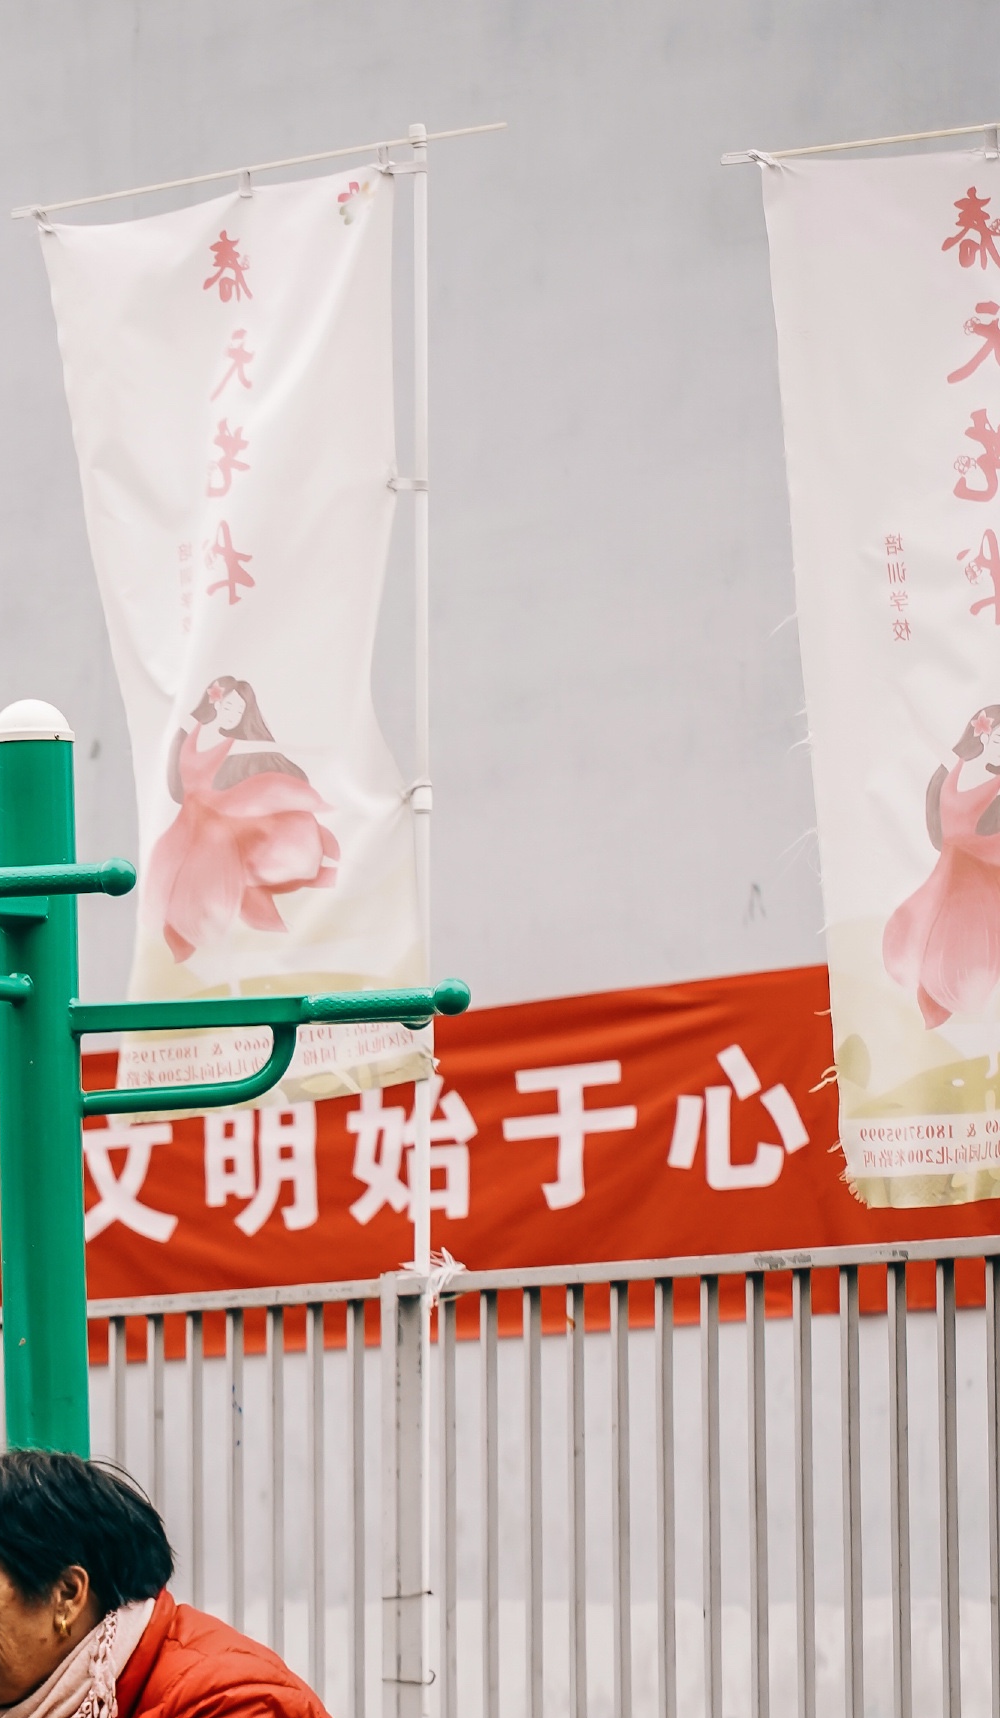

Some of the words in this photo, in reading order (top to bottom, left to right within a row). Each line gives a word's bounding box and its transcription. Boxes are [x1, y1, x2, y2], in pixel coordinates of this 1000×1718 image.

[83, 1045, 810, 1243] 文明始于心
